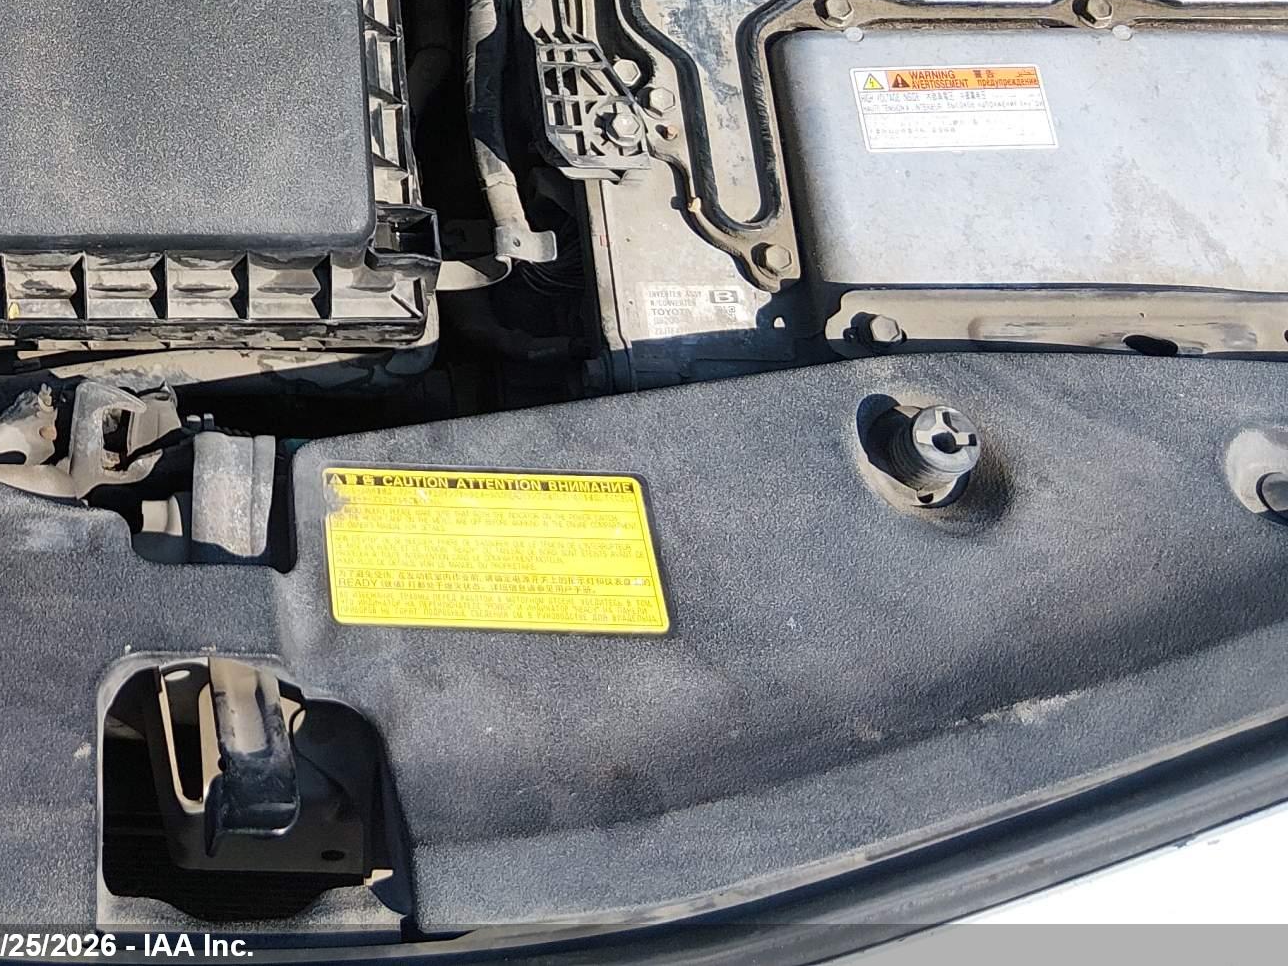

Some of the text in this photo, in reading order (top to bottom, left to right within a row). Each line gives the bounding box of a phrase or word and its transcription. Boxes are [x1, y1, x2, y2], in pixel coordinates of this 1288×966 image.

[908, 70, 956, 80] WARNING
[912, 78, 969, 90] AVERTISSEMENT
[382, 475, 449, 489] CAUTION
[456, 478, 542, 491] ATTENTION
[548, 480, 633, 493] ВНИМАНИЕ
